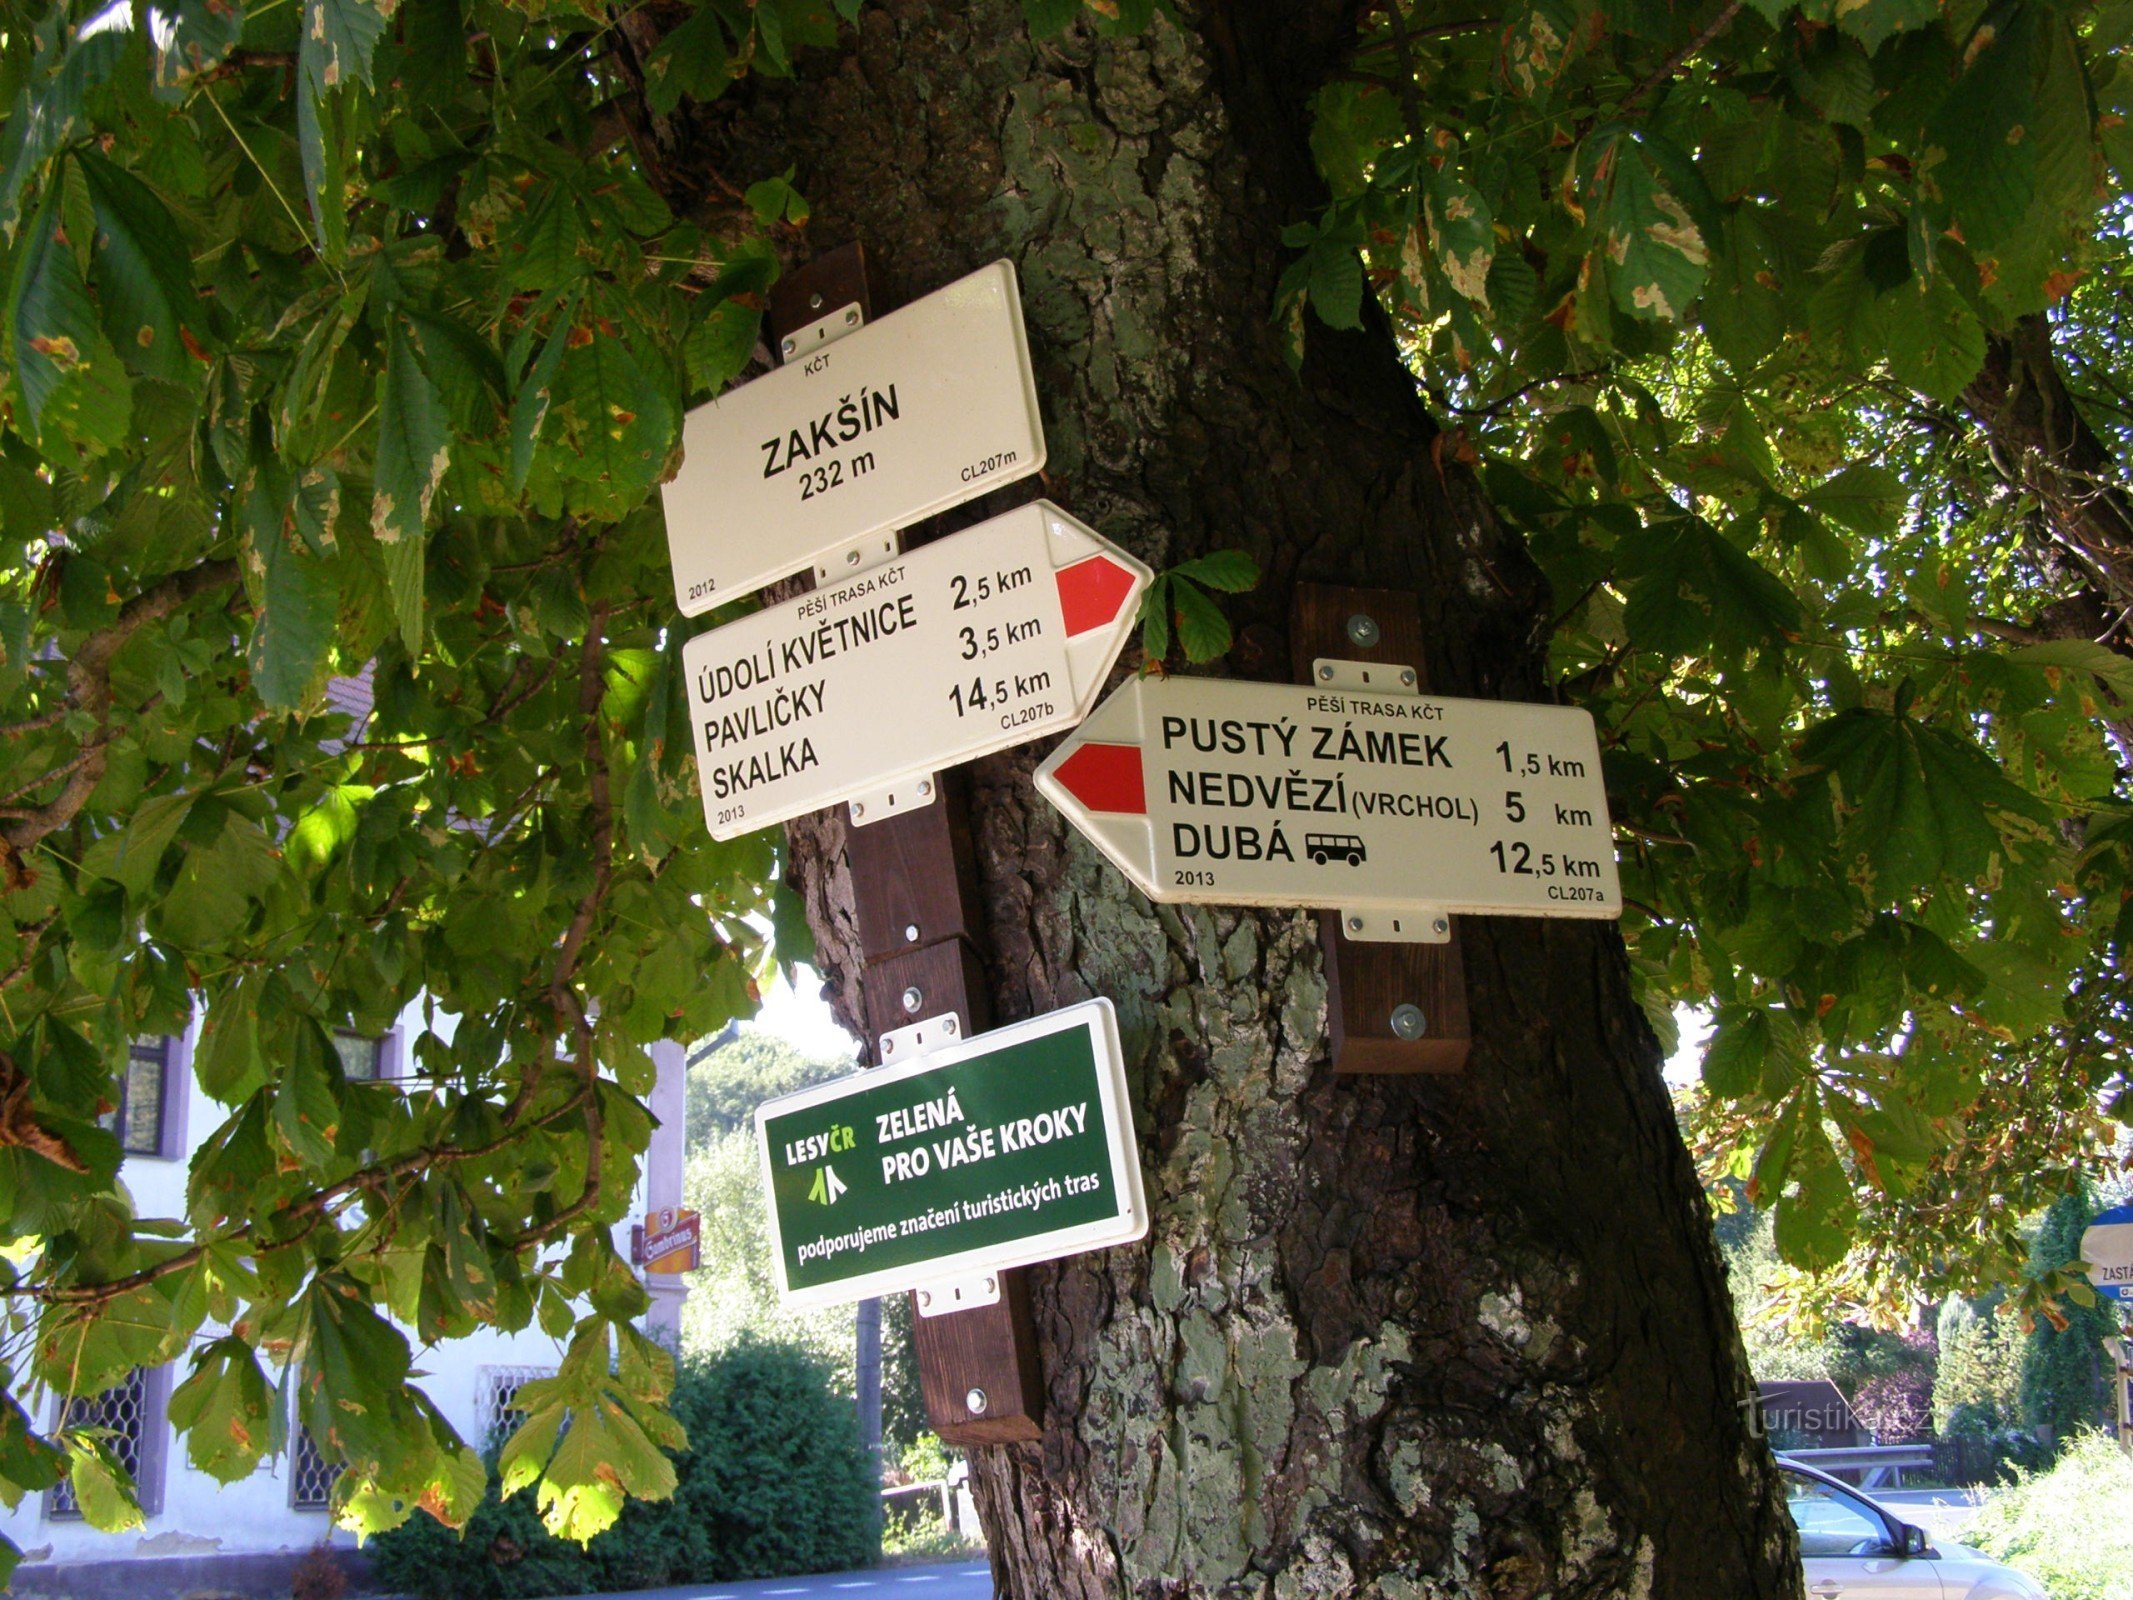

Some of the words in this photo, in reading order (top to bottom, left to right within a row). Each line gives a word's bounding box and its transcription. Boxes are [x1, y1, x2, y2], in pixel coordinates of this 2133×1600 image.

[804, 353, 830, 377] KČT
[761, 383, 900, 479] ZAKŠÍN
[799, 459, 844, 501] 232
[851, 451, 875, 478] m
[960, 451, 1017, 482] CL207m
[688, 578, 716, 601] 2012
[797, 594, 827, 621] PĚŠÍ
[829, 579, 876, 607] TRASA
[878, 566, 905, 589] KČT
[698, 639, 776, 704] ÚDOLÍ
[781, 593, 917, 673] KVĚTNICE
[950, 575, 990, 611] 2,5
[996, 566, 1032, 594] km
[704, 679, 826, 753] PAVLIČKY
[959, 626, 1000, 661] 3,5
[1005, 618, 1042, 645] km
[1306, 695, 1345, 714] PĚŠÍ
[1349, 700, 1408, 718] TRASA
[1411, 703, 1444, 721] KČT
[712, 737, 819, 800] SKALKA
[948, 676, 1008, 718] 14,5
[1014, 671, 1051, 698] km
[1000, 701, 1054, 730] CL207b
[1162, 716, 1298, 757] PUSTÝ
[1311, 720, 1453, 768] ZÁMEK
[1495, 740, 1541, 778] 1,5
[1547, 754, 1585, 778] km
[717, 804, 745, 825] 2013
[1168, 768, 1347, 814] NEDVĚZÍ
[1352, 791, 1479, 827] (VRCHOL)
[1505, 790, 1526, 823] 5
[1554, 803, 1593, 827] km
[1172, 819, 1295, 863] DUBÁ
[1490, 840, 1556, 879] 12,5
[1562, 854, 1601, 878] km
[1174, 870, 1215, 887] 2013
[1547, 885, 1605, 902] CL207a
[875, 1085, 965, 1144] ZELENÁ
[881, 1146, 930, 1185] PRO
[932, 1125, 996, 1170] VAŠE
[999, 1102, 1087, 1154] KROKY
[797, 1223, 898, 1267] podporujeme
[899, 1200, 961, 1236] značení
[962, 1177, 1062, 1221] turistických
[1063, 1172, 1100, 1196] tras
